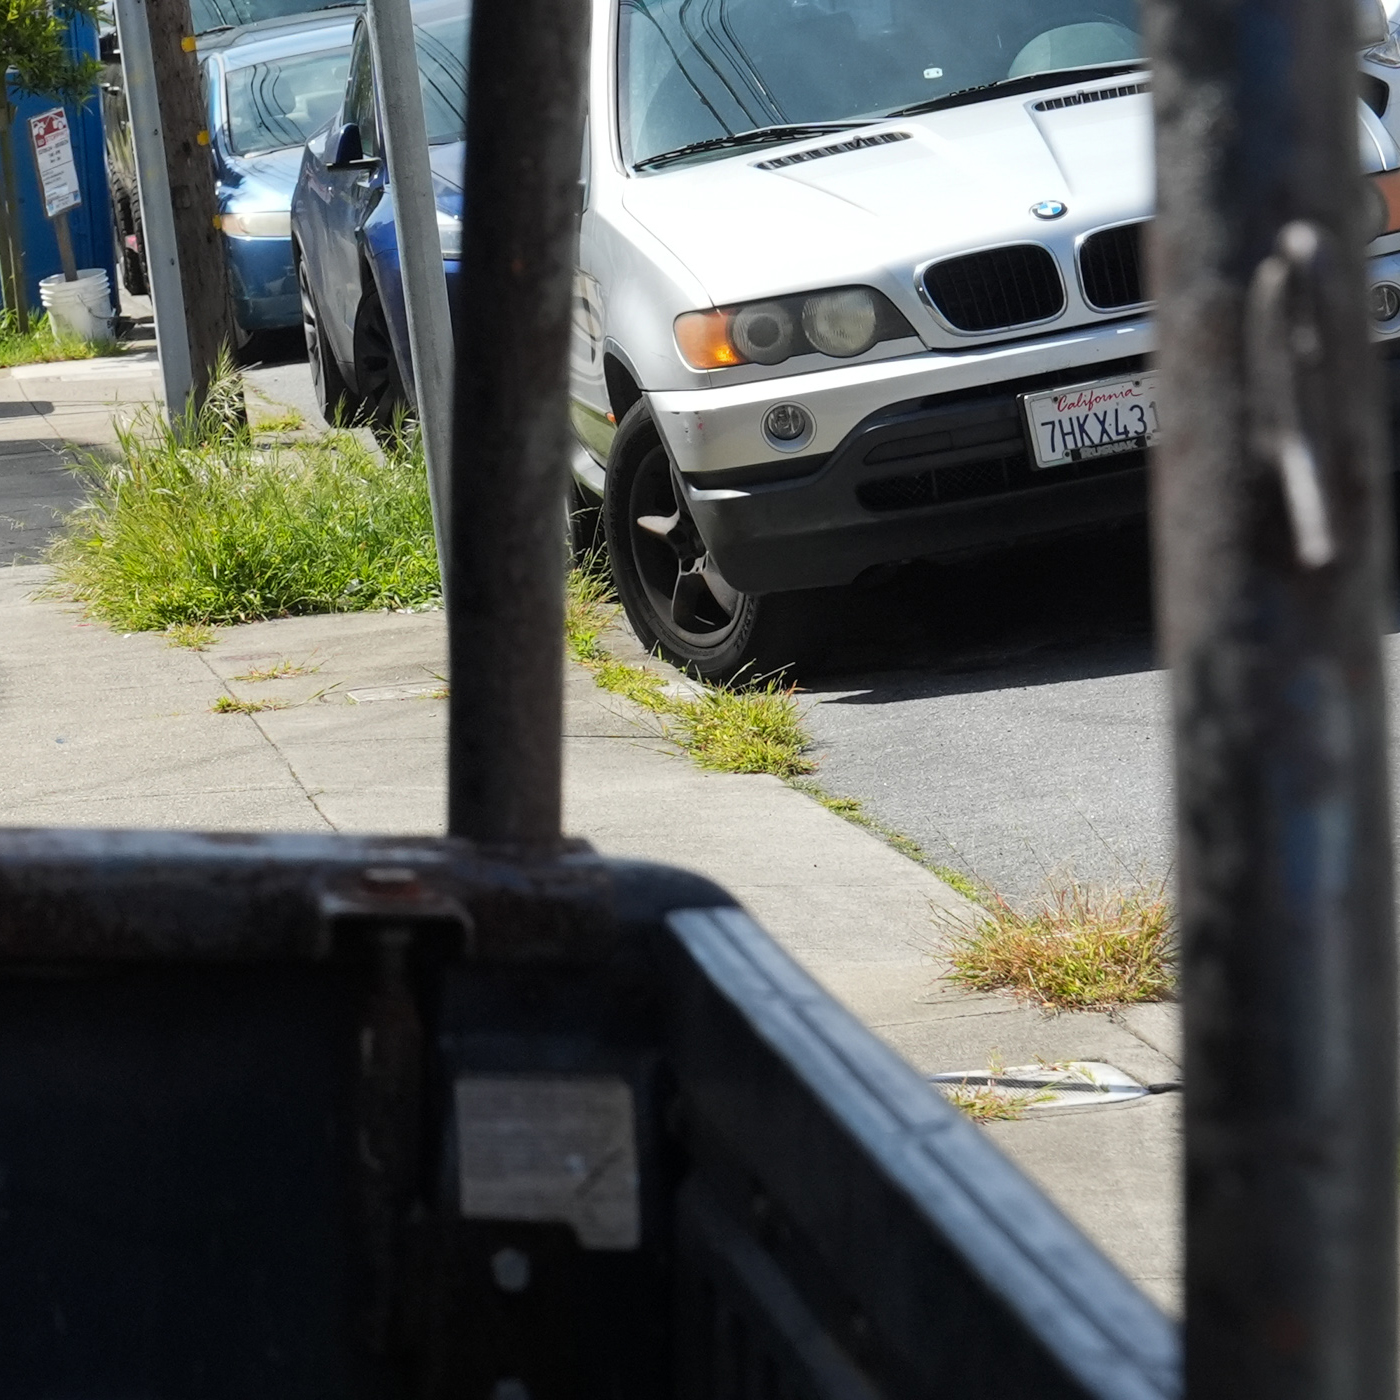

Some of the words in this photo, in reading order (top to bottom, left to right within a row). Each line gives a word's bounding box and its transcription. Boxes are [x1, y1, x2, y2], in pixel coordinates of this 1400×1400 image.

[1057, 388, 1143, 412] California
[1041, 401, 1160, 454] 7HKX431
[1079, 439, 1138, 458] RUSNAK
